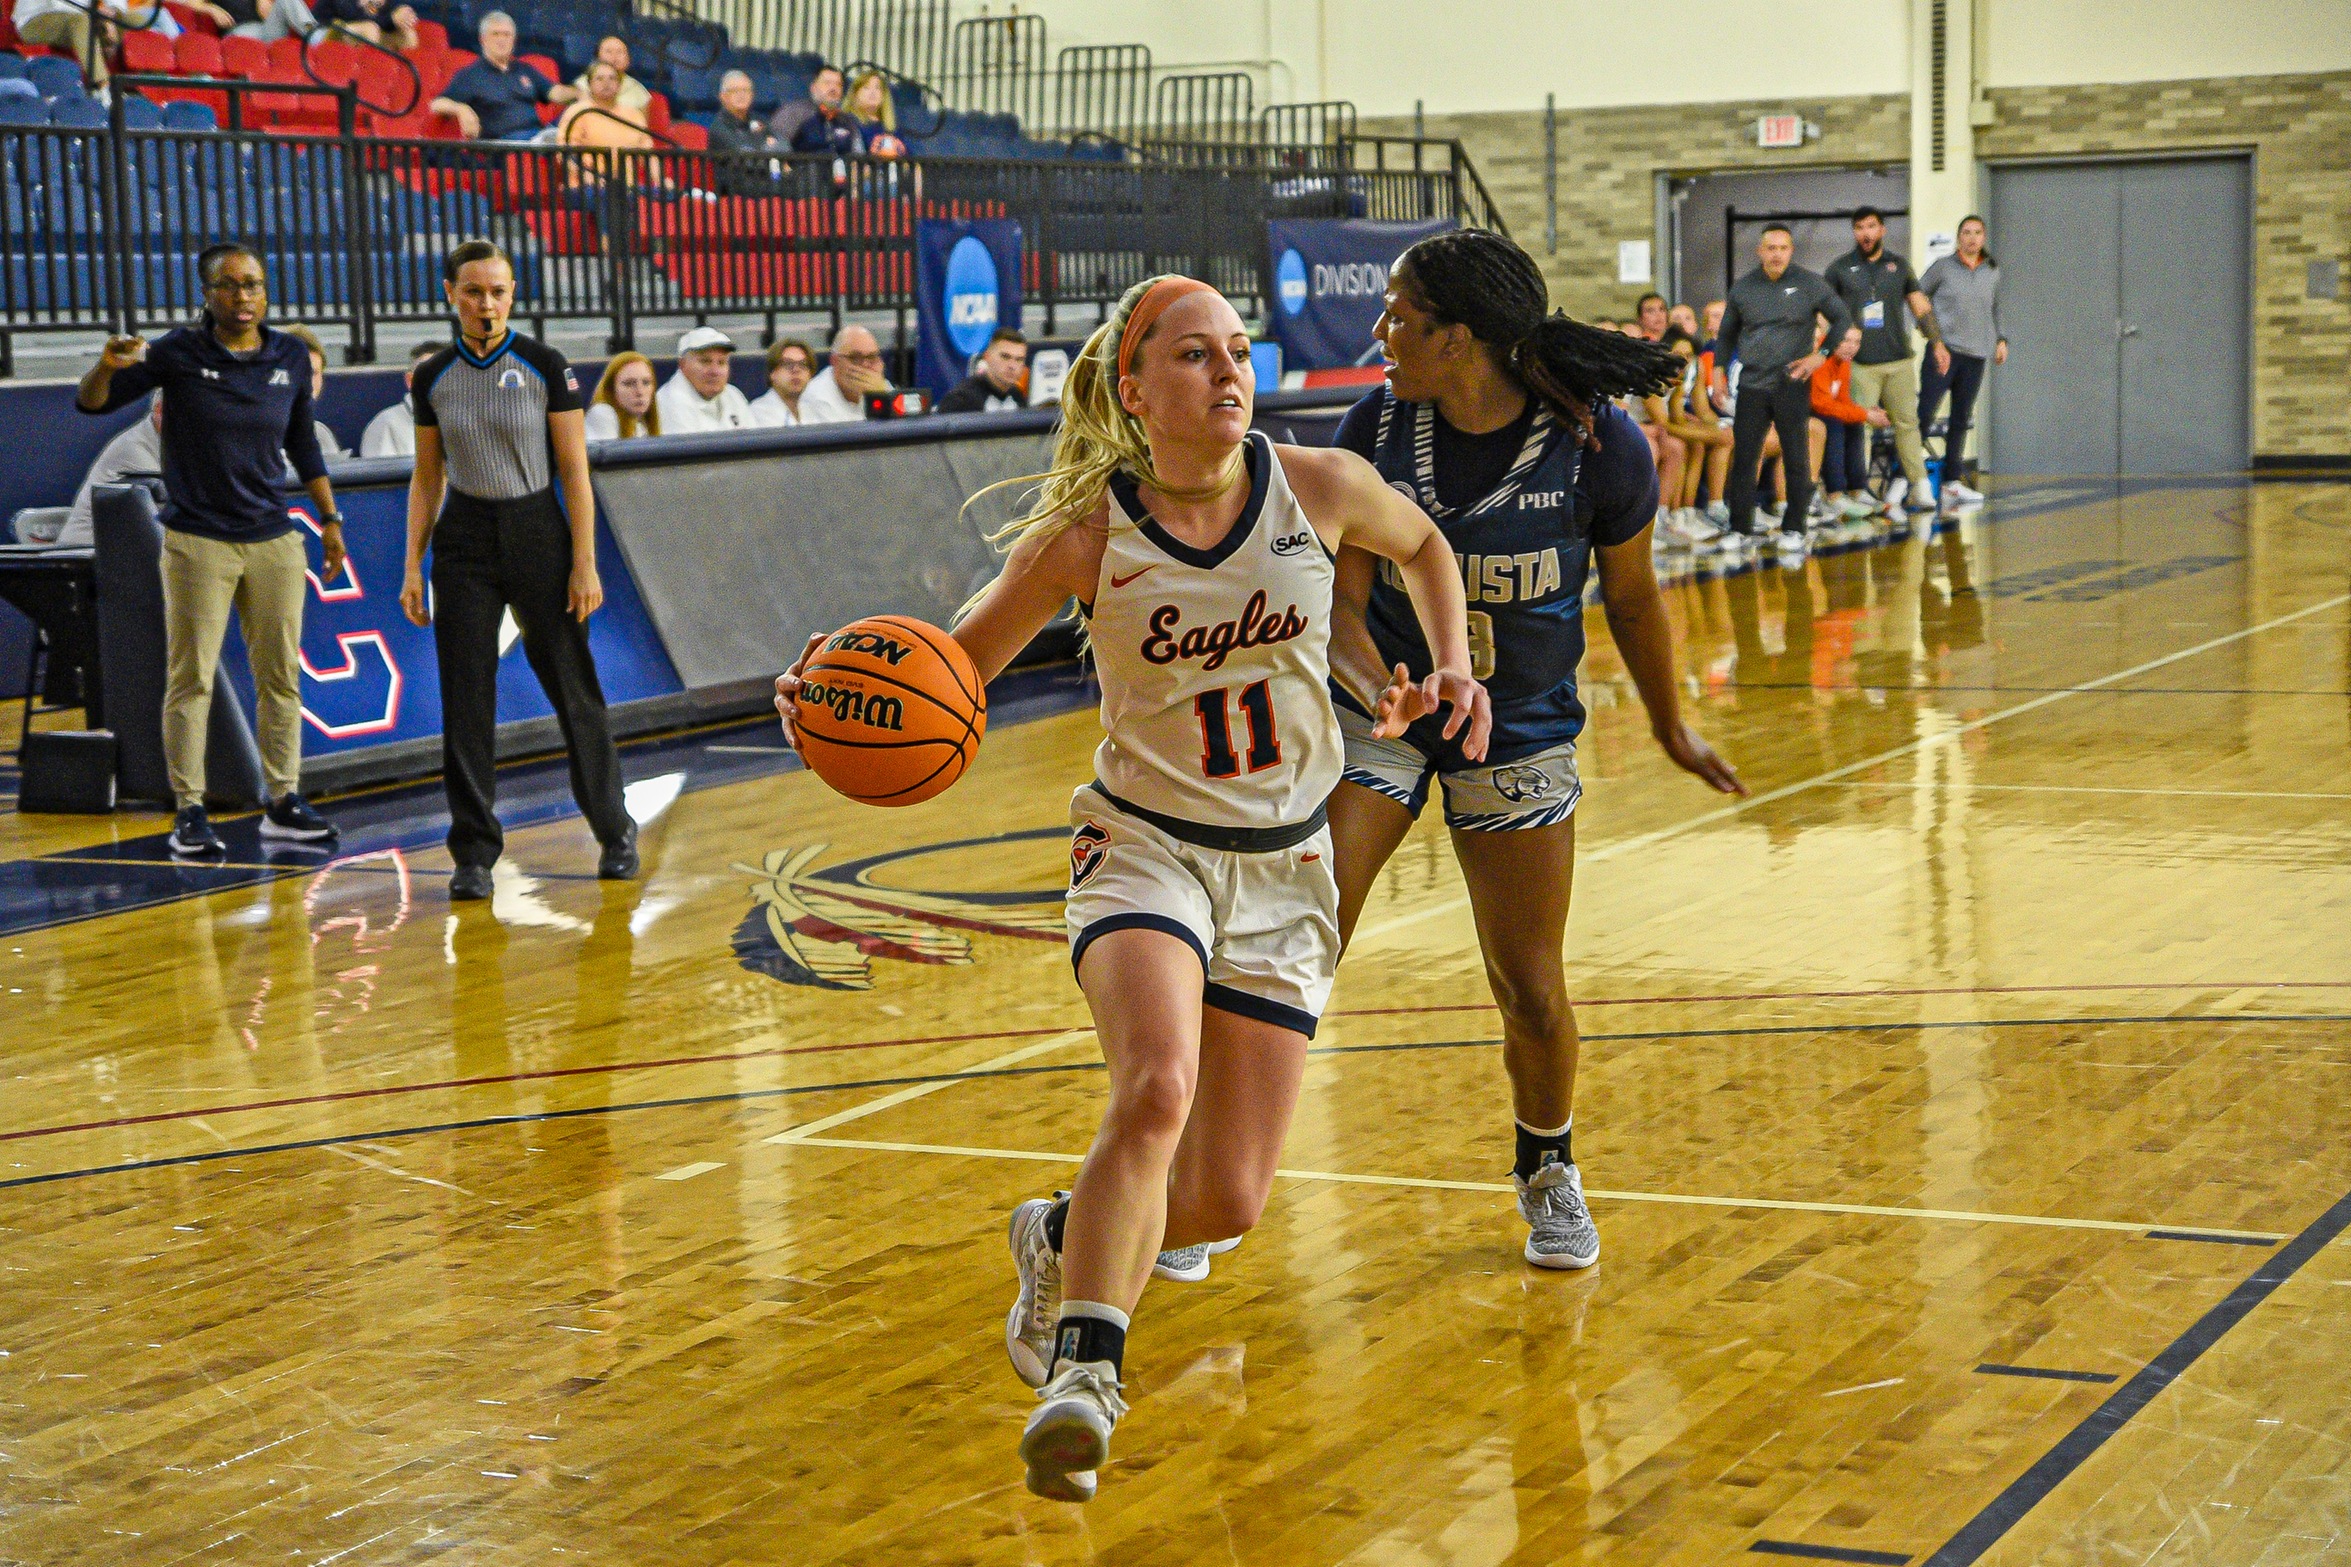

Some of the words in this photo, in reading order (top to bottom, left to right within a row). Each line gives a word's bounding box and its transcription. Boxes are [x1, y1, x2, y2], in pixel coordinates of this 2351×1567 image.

[1313, 262, 1390, 297] DIVISION
[1518, 491, 1565, 510] PBC
[1276, 532, 1309, 548] SAC
[1140, 588, 1309, 672] Eagles
[824, 632, 912, 666] NCAA
[800, 679, 904, 731] Wilson
[1193, 677, 1283, 779] 11
